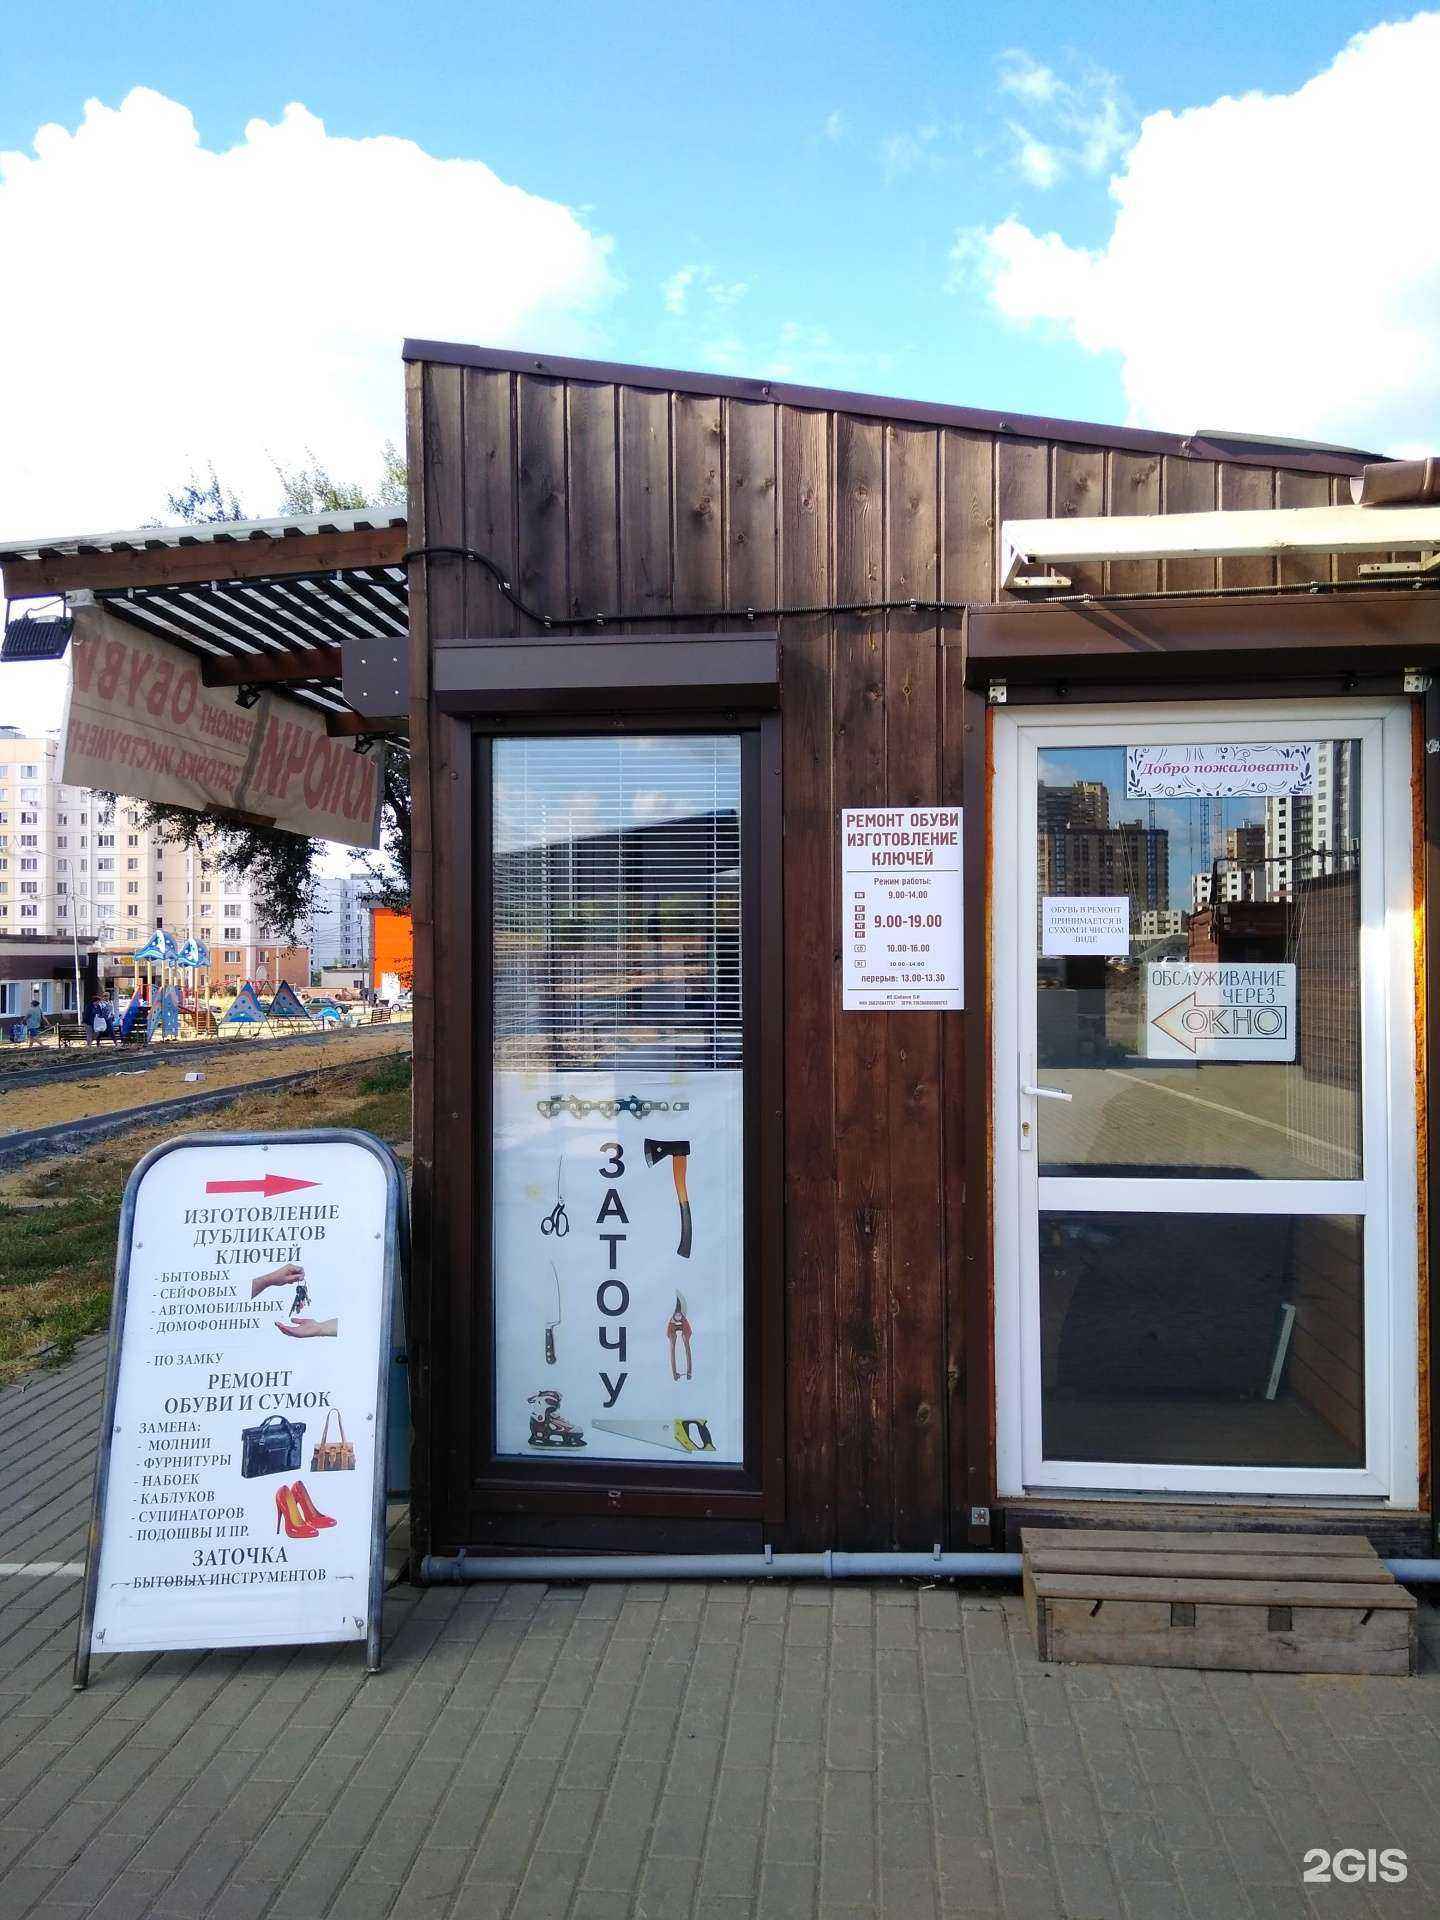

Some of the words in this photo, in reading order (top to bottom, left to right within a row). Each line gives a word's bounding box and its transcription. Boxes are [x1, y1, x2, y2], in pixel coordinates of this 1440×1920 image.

[1140, 763, 1190, 776] Добро
[1193, 762, 1299, 773] пожаловать
[847, 814, 904, 827] РЕМОНТ
[910, 813, 958, 827] ОБУВИ
[847, 832, 958, 846] ИЗГОТОВЛЕНИЕ
[872, 849, 933, 865] КЛЮЧЕЙ
[902, 878, 932, 886] работы:
[874, 915, 942, 928] 9.00-19.00
[887, 944, 930, 952] 10.00-16.00
[861, 975, 898, 983] перерыв:
[902, 974, 945, 982] 13.00-13.30
[1152, 970, 1286, 987] ОБСЛУЖИВАНИЕ
[1222, 988, 1275, 1004] ЧЕРЕЗ
[1182, 1008, 1282, 1035] ОКНО
[184, 1205, 339, 1224] ИЗГОТОВЛЕНИЕ
[193, 1226, 326, 1246] ДУБЛИКАТОВ
[215, 1244, 301, 1265] КЛЮЧЕЙ
[161, 1270, 230, 1283] БЫТОВЫХ
[595, 1142, 630, 1408] ЗАТОЧУ
[160, 1285, 238, 1299] СЕЙФОВЫХ
[159, 1300, 284, 1316] АВТОМОБИЛЬНЫХ
[156, 1318, 260, 1334] ДОМОФОННЫХ
[154, 1355, 174, 1366] ПО
[176, 1353, 224, 1366] ЗАМКУ
[208, 1371, 292, 1390] РЕМОНТ
[164, 1394, 233, 1414] ОБУВИ
[238, 1394, 253, 1411] И
[258, 1391, 331, 1410] СУМОК
[139, 1421, 201, 1435] ЗАМЕНА:
[148, 1437, 211, 1451] МОЛНИИ
[143, 1454, 232, 1469] ФУРНИТУРЫ
[142, 1473, 200, 1487] НАБОЕК
[140, 1491, 215, 1505] КАБЛУКОВ
[138, 1508, 244, 1523] СУПИНАТОРОВ
[137, 1526, 212, 1542] ПОДОШВЫ
[216, 1526, 227, 1538] И
[192, 1547, 288, 1566] ЗАТОЧКА
[133, 1575, 206, 1589] БЫТОВЫХ
[208, 1568, 327, 1585] ИНСТРУМЕНТОВ
